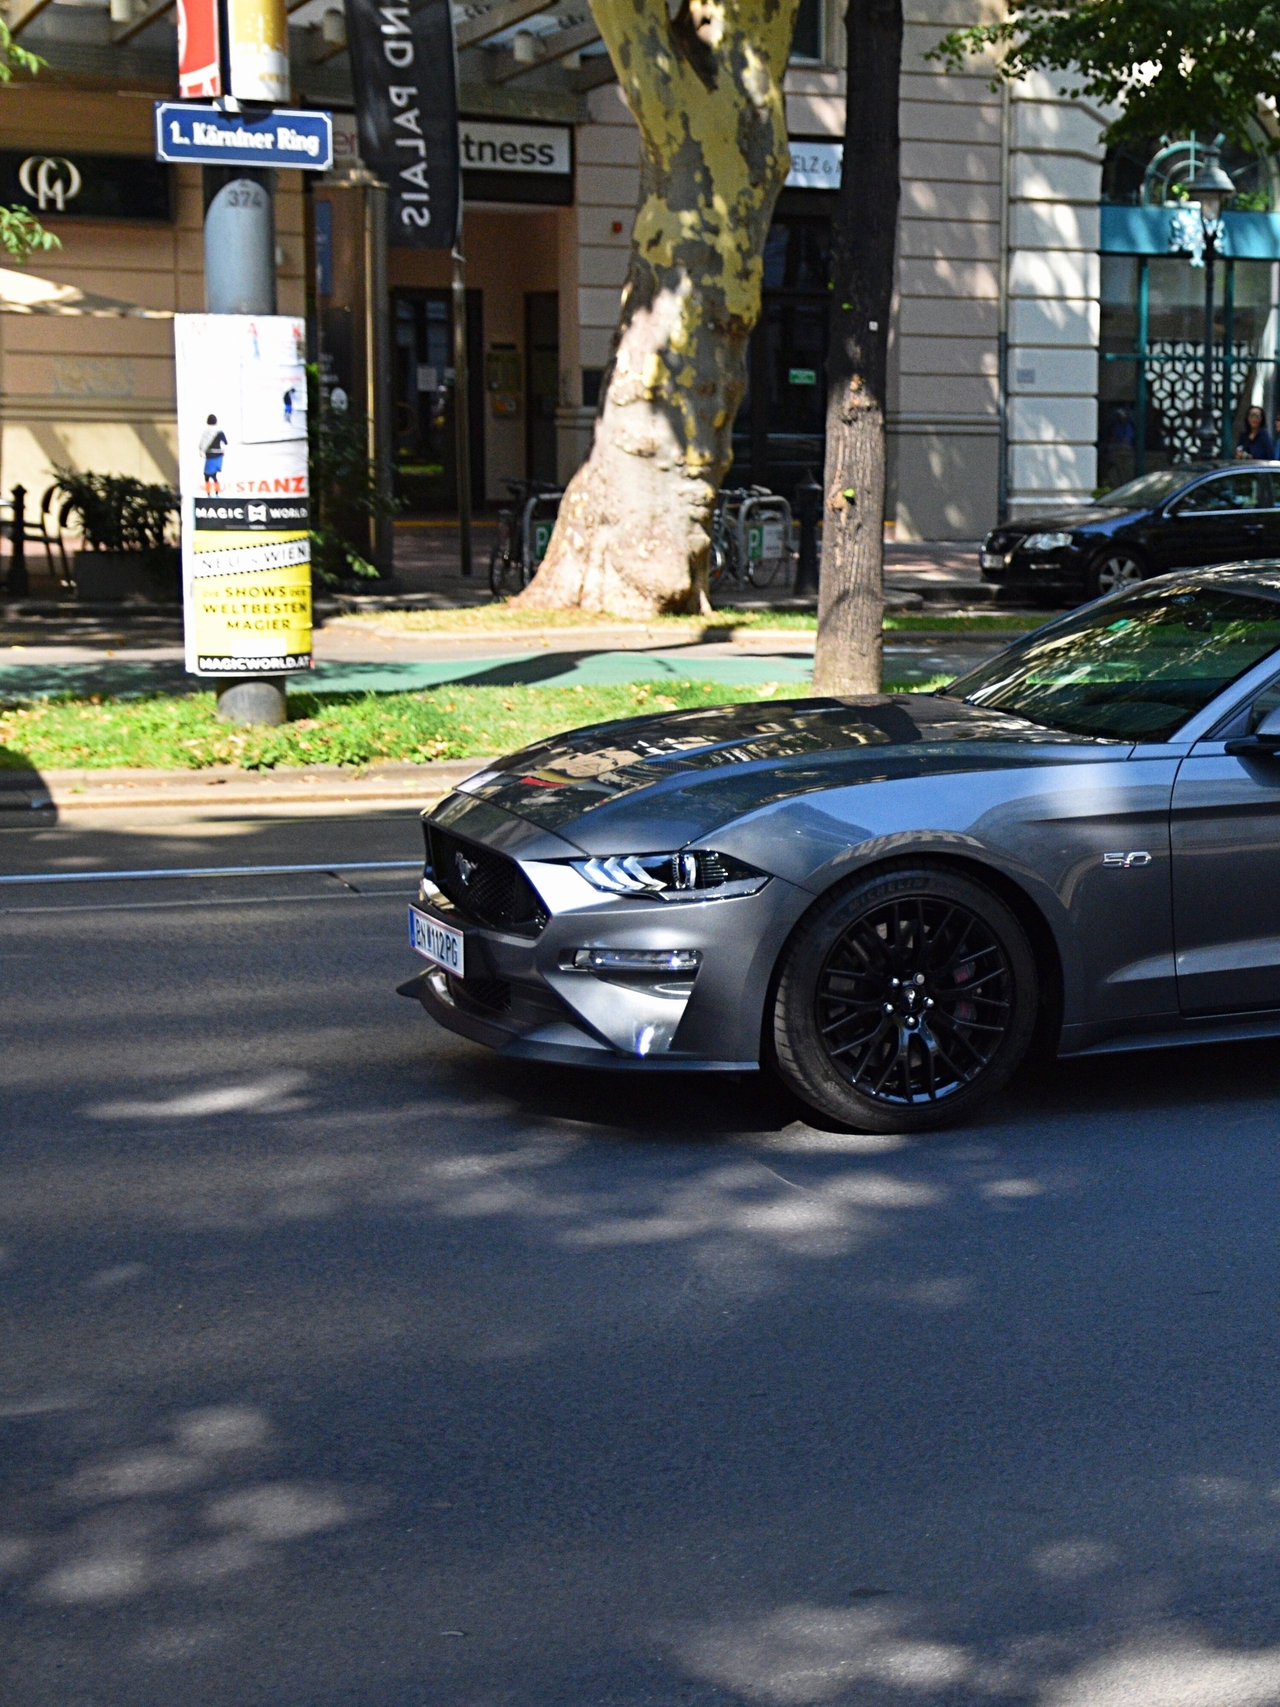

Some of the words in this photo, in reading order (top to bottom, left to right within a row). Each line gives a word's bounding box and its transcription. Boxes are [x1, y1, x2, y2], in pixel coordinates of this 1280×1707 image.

[193, 121, 274, 149] Kärntner
[277, 127, 320, 157] Ring
[461, 133, 554, 165] tness
[195, 507, 245, 520] MAGIC
[269, 507, 309, 519] WORLD
[748, 528, 760, 558] P
[264, 545, 307, 563] WIEN
[225, 585, 288, 598] SHOWS
[203, 602, 308, 615] WELTBESTEN
[226, 619, 291, 630] MAGIER
[200, 655, 310, 671] MAGICWORLD.AT
[1103, 851, 1152, 868] 5.0
